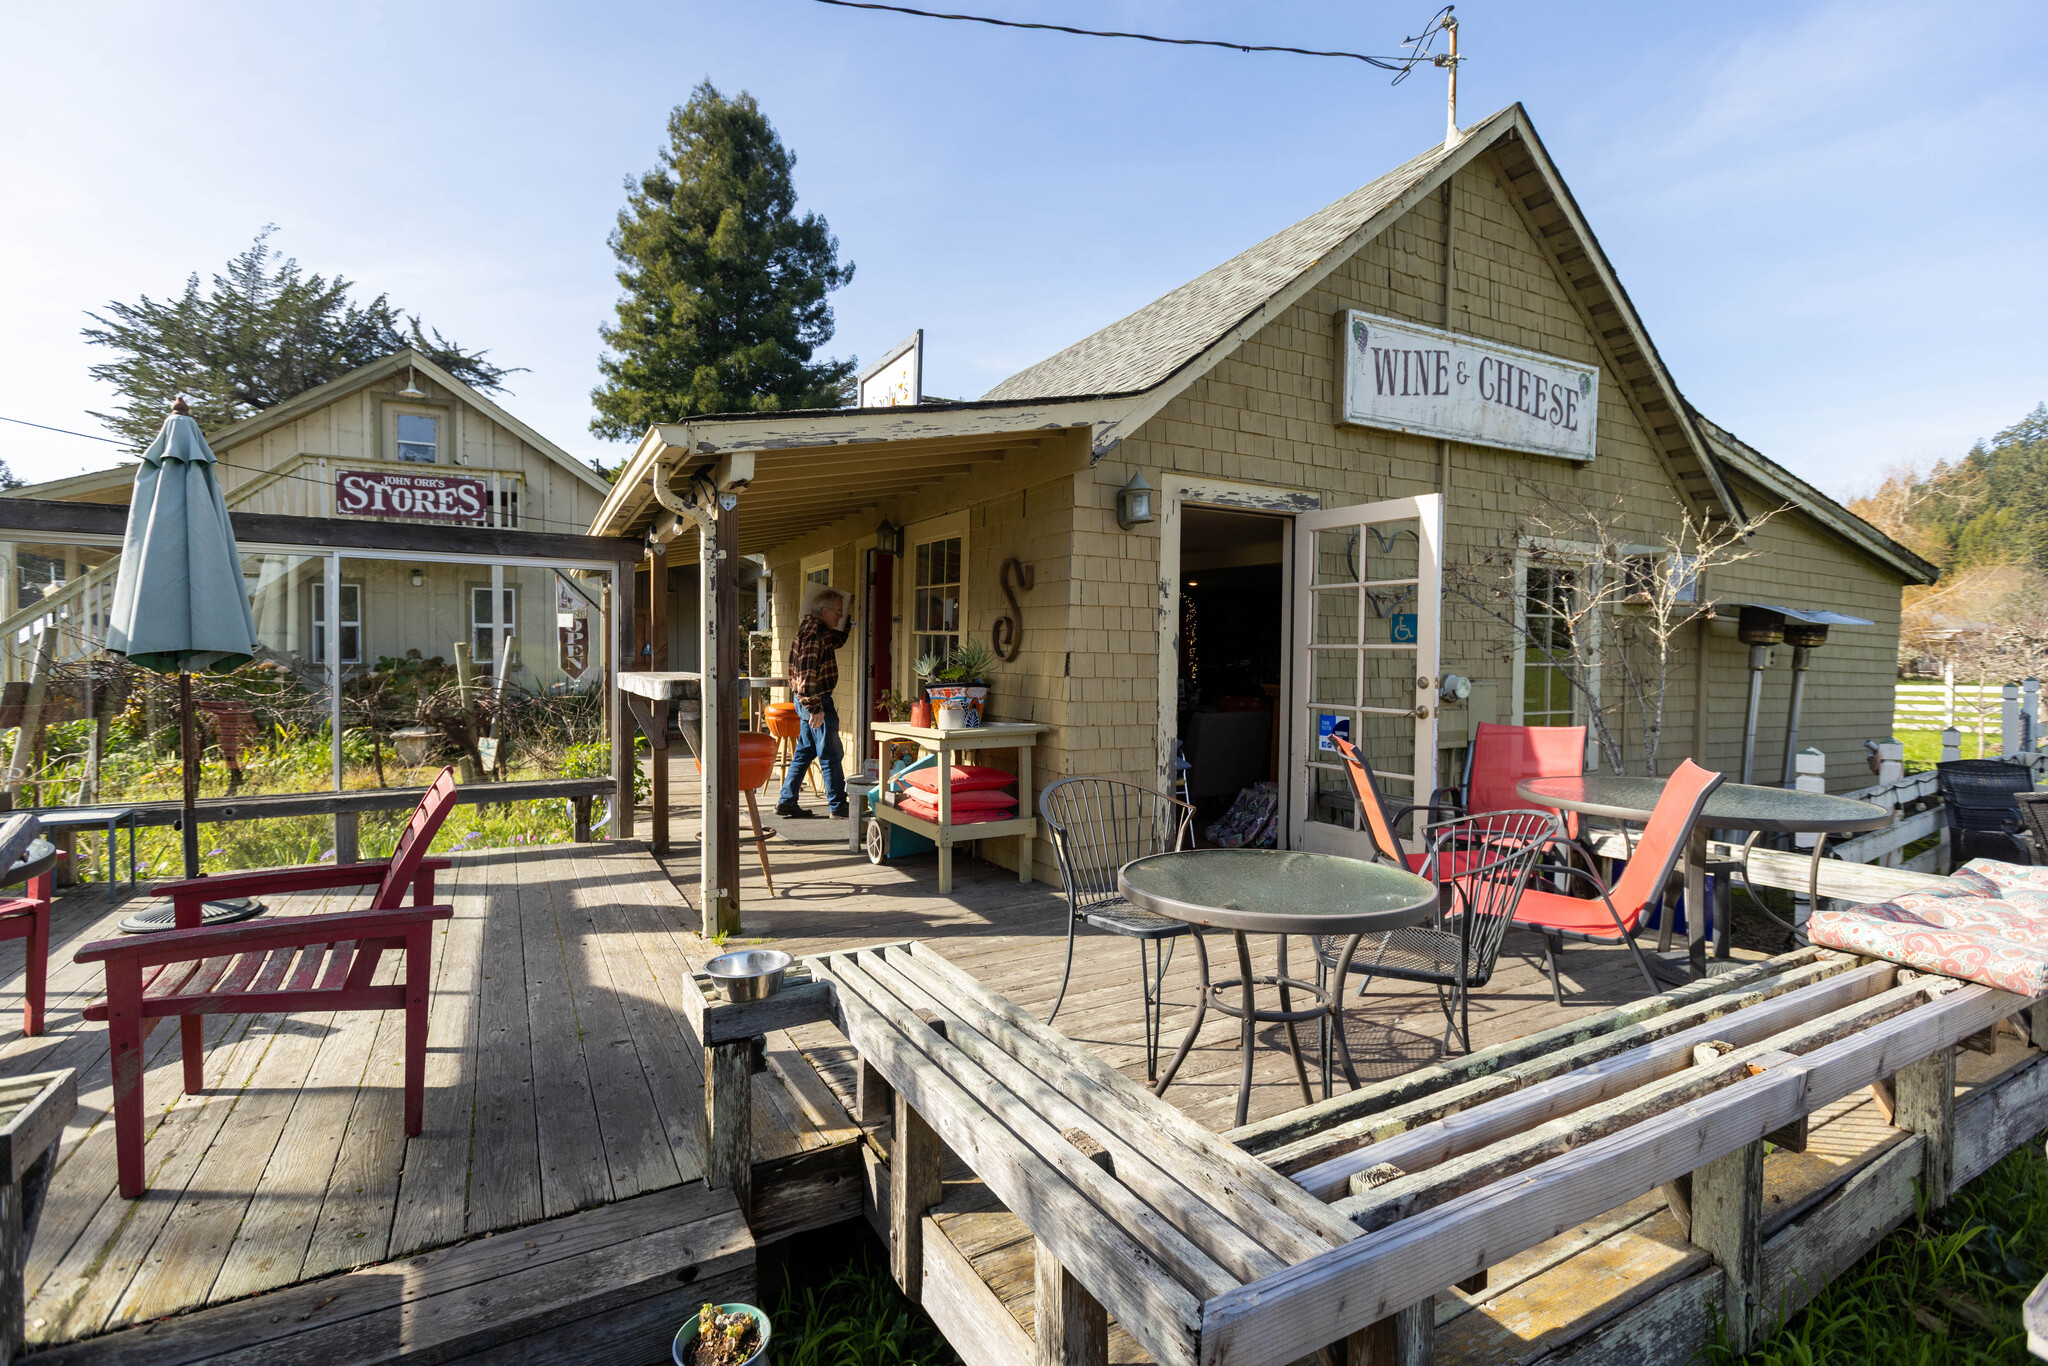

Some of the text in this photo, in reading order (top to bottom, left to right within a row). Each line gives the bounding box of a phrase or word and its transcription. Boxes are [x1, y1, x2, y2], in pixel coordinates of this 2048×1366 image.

[1371, 346, 1579, 432] WINE & CHEESE
[343, 476, 481, 516] STORES
[381, 476, 446, 488] JOHN ORR'S
[565, 619, 584, 670] OPEN
